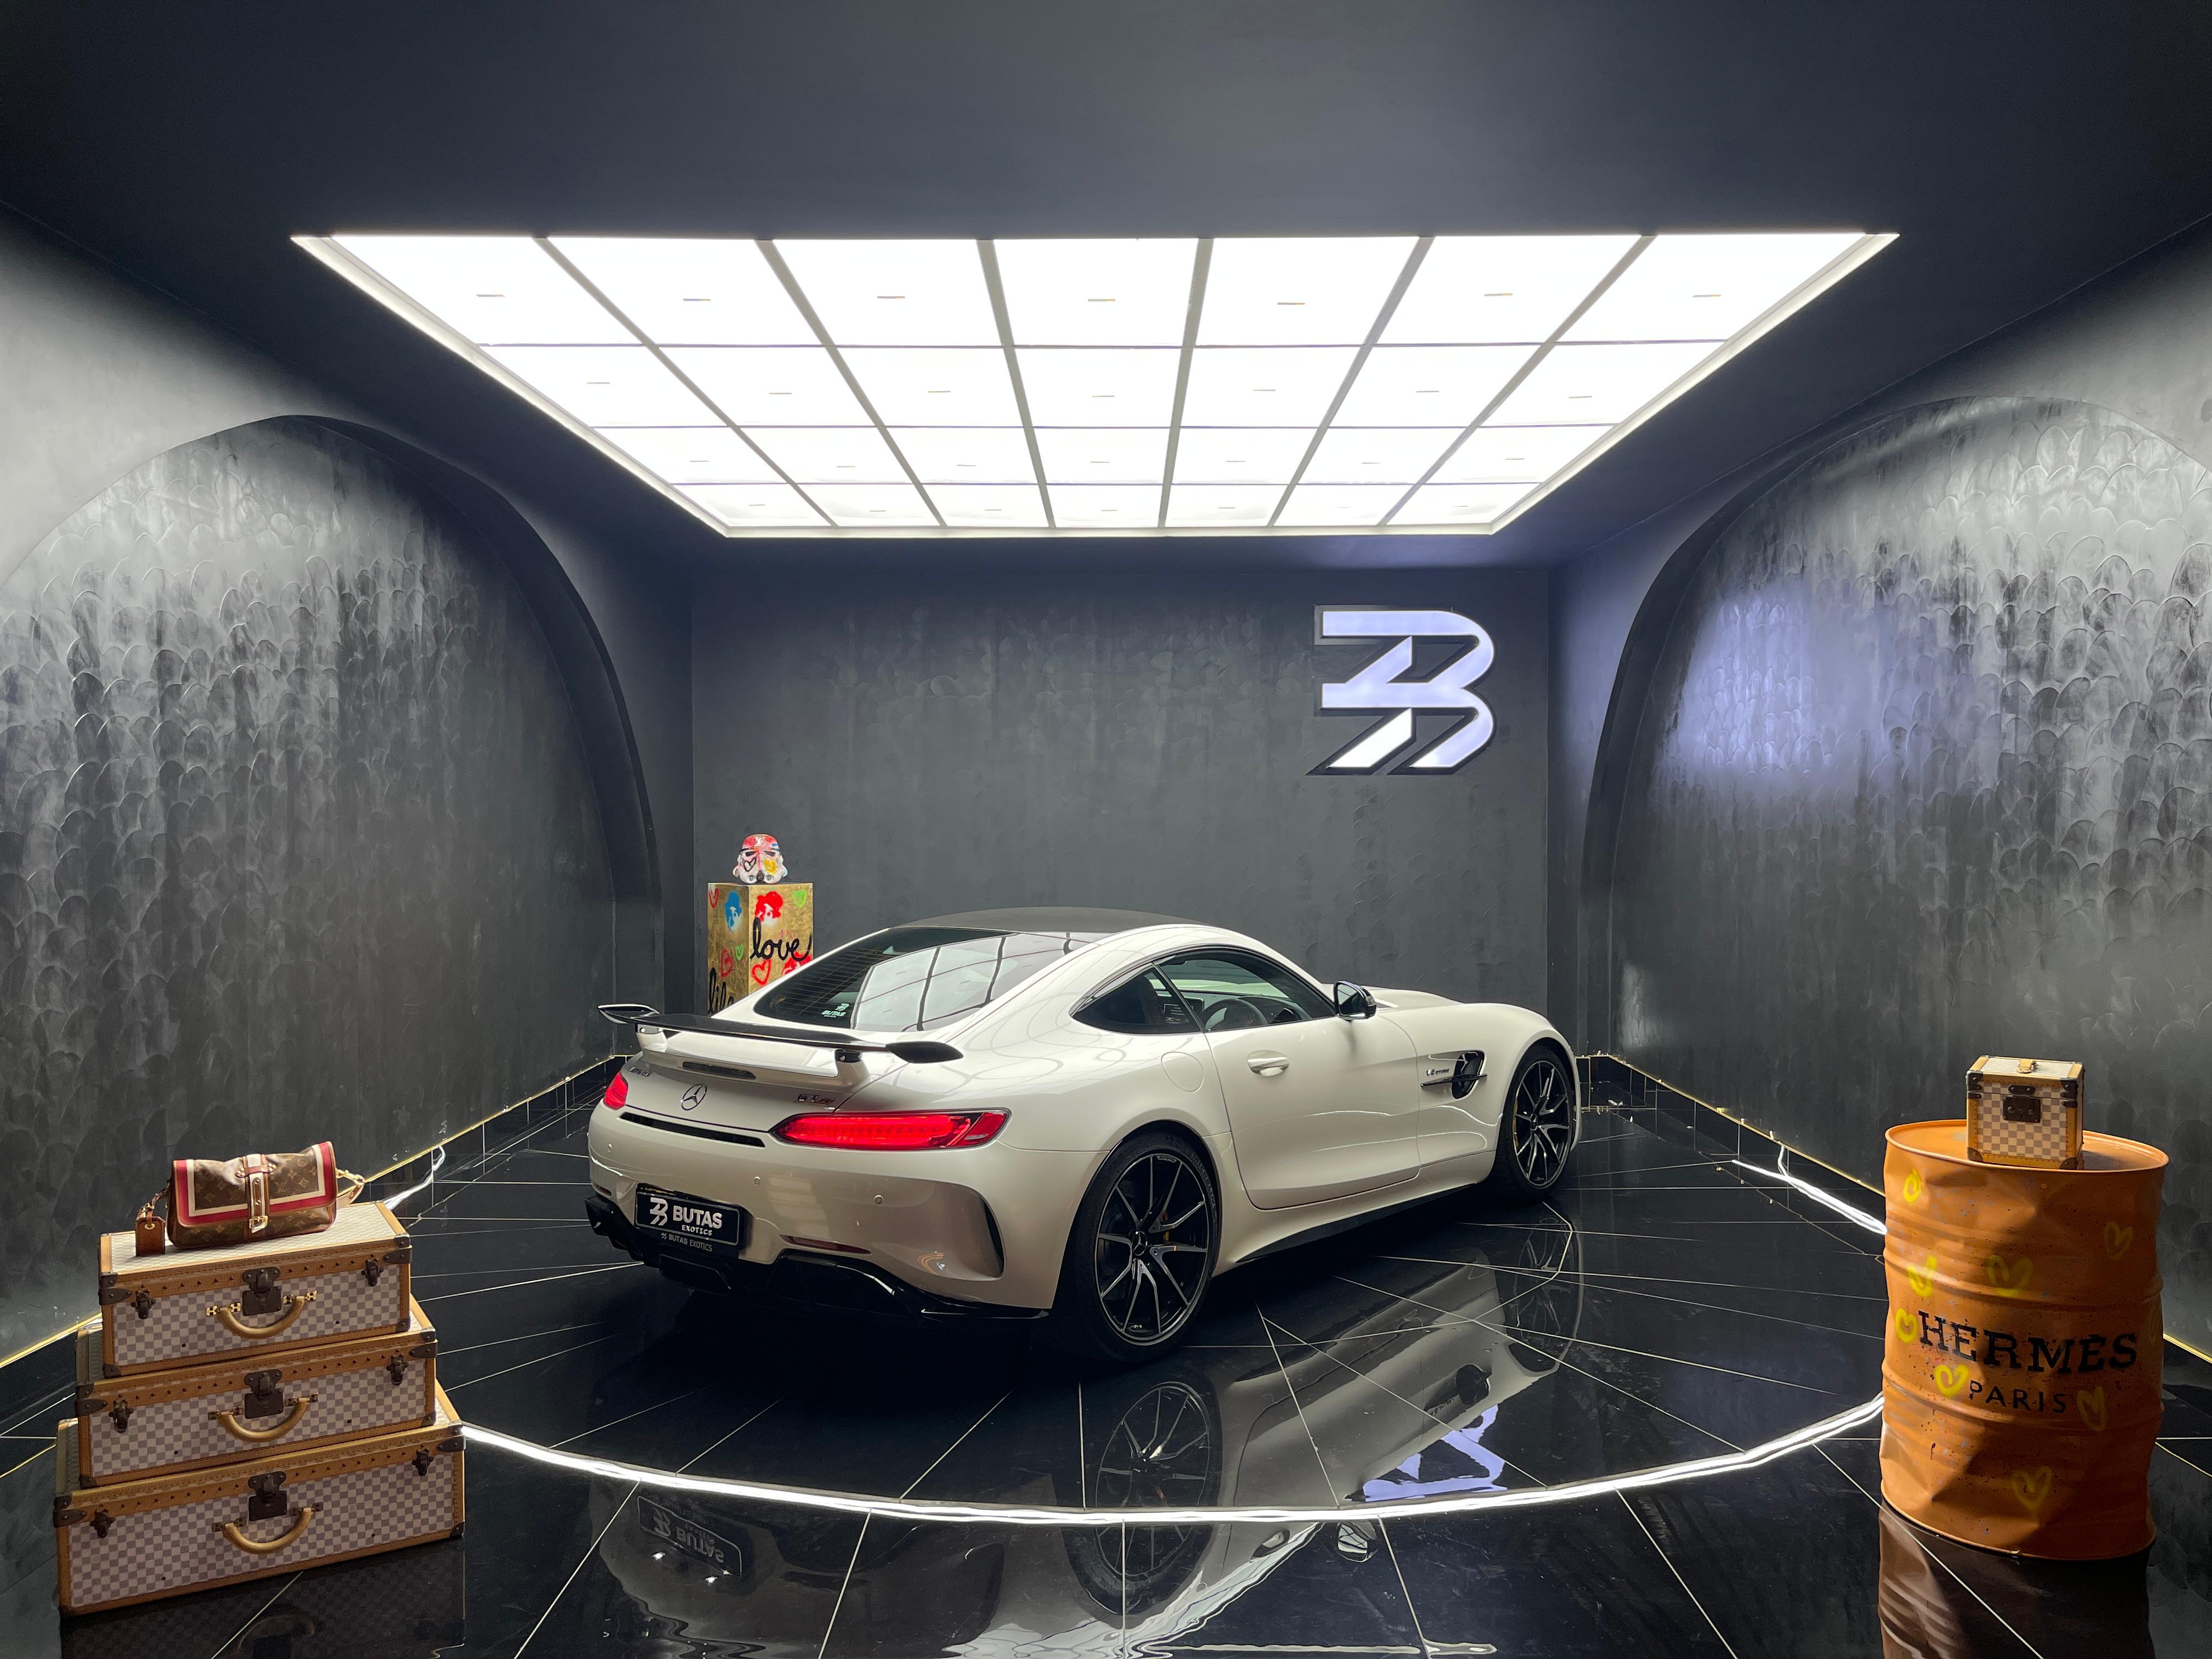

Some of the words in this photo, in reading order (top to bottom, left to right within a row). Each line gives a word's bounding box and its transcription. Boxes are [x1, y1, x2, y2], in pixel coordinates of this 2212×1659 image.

[750, 917, 812, 961] love
[673, 1205, 723, 1229] BUTAS
[668, 1233, 688, 1245] BUTAS
[690, 1239, 713, 1251] EXOTICS
[681, 1224, 713, 1236] EXOTICS
[1968, 1379, 2067, 1414] PARIS
